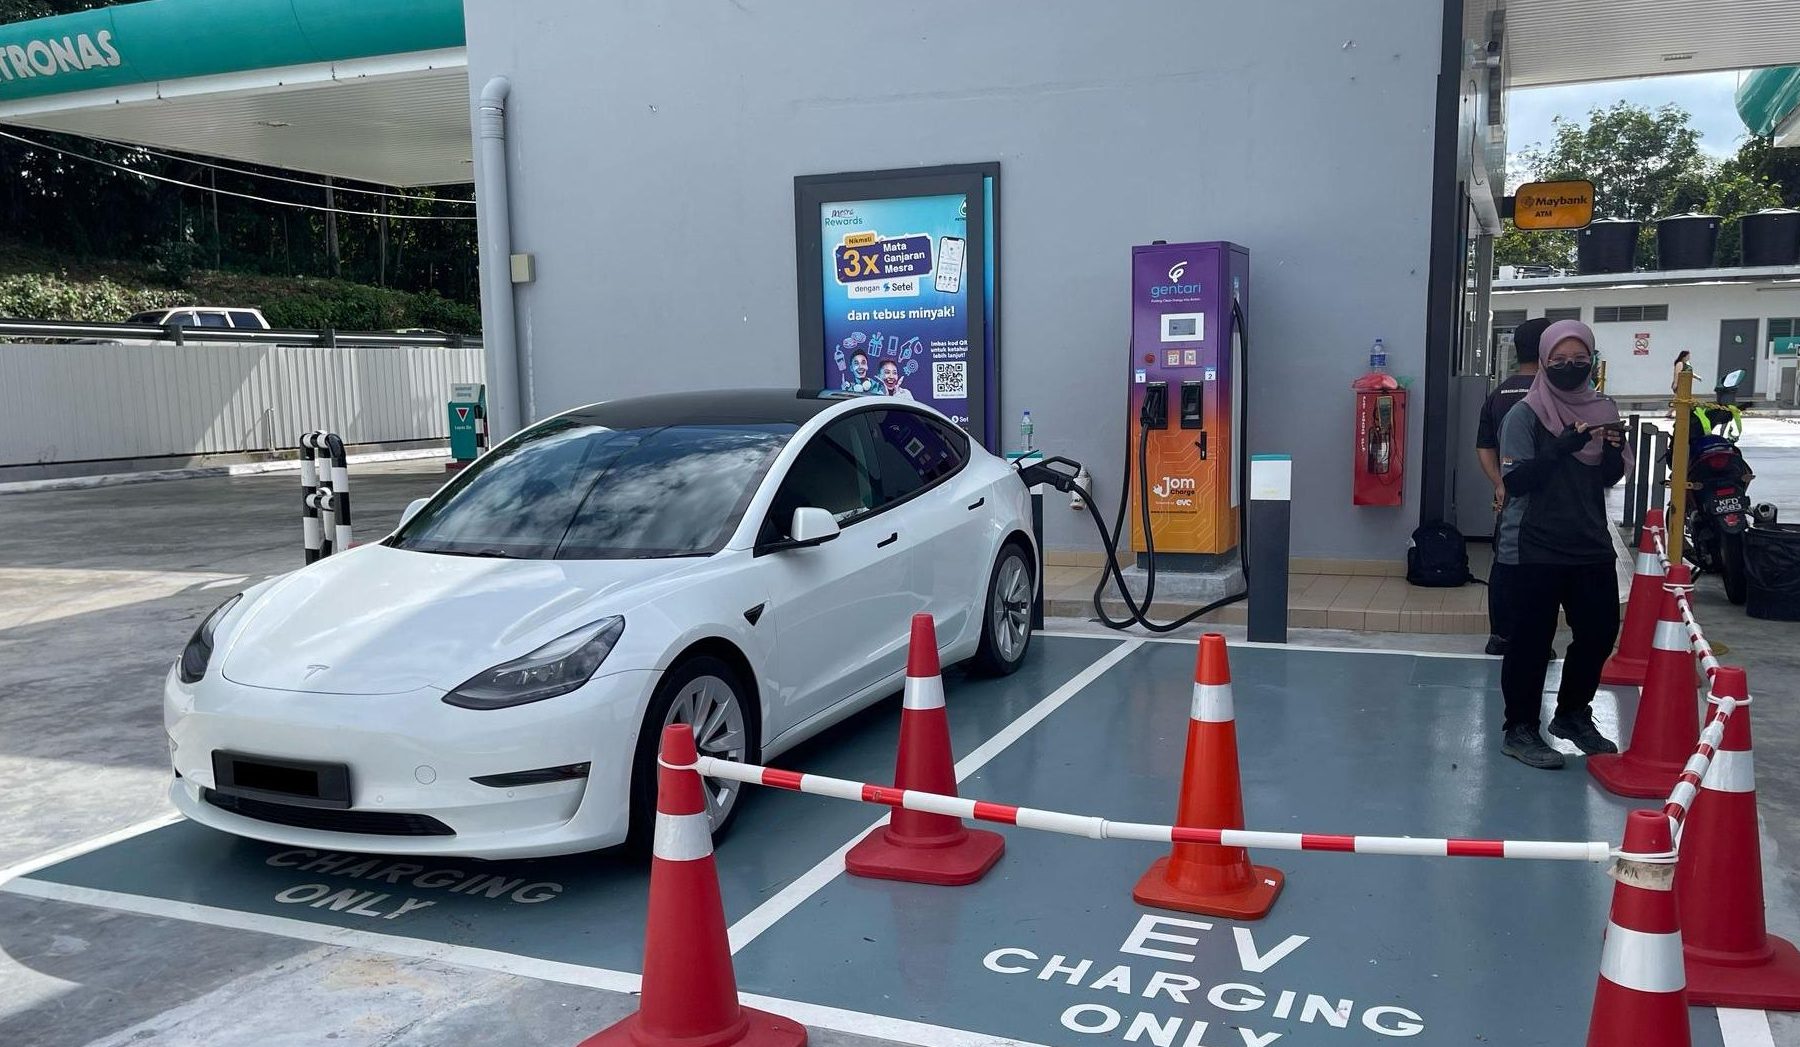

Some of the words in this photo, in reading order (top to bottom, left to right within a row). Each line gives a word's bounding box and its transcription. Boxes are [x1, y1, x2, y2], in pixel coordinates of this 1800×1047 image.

[1536, 195, 1588, 207] Maybank
[825, 216, 863, 227] Rewards
[848, 236, 872, 245] Nikmati
[883, 242, 907, 252] Mata
[843, 249, 881, 277] 3x
[884, 251, 925, 263] Ganjaran
[885, 264, 914, 274] Mesra
[854, 285, 880, 293] dengan
[892, 282, 914, 291] Setel
[1151, 282, 1201, 298] gentari
[847, 309, 870, 320] dan
[873, 308, 906, 320] tebus
[908, 305, 955, 320] minyak!
[1162, 476, 1195, 498] Jom
[1170, 489, 1195, 497] Charge
[265, 850, 563, 904] CHARGING
[274, 884, 436, 920] ONLY
[1119, 913, 1311, 974] EV
[981, 947, 1425, 1037] CHARGING
